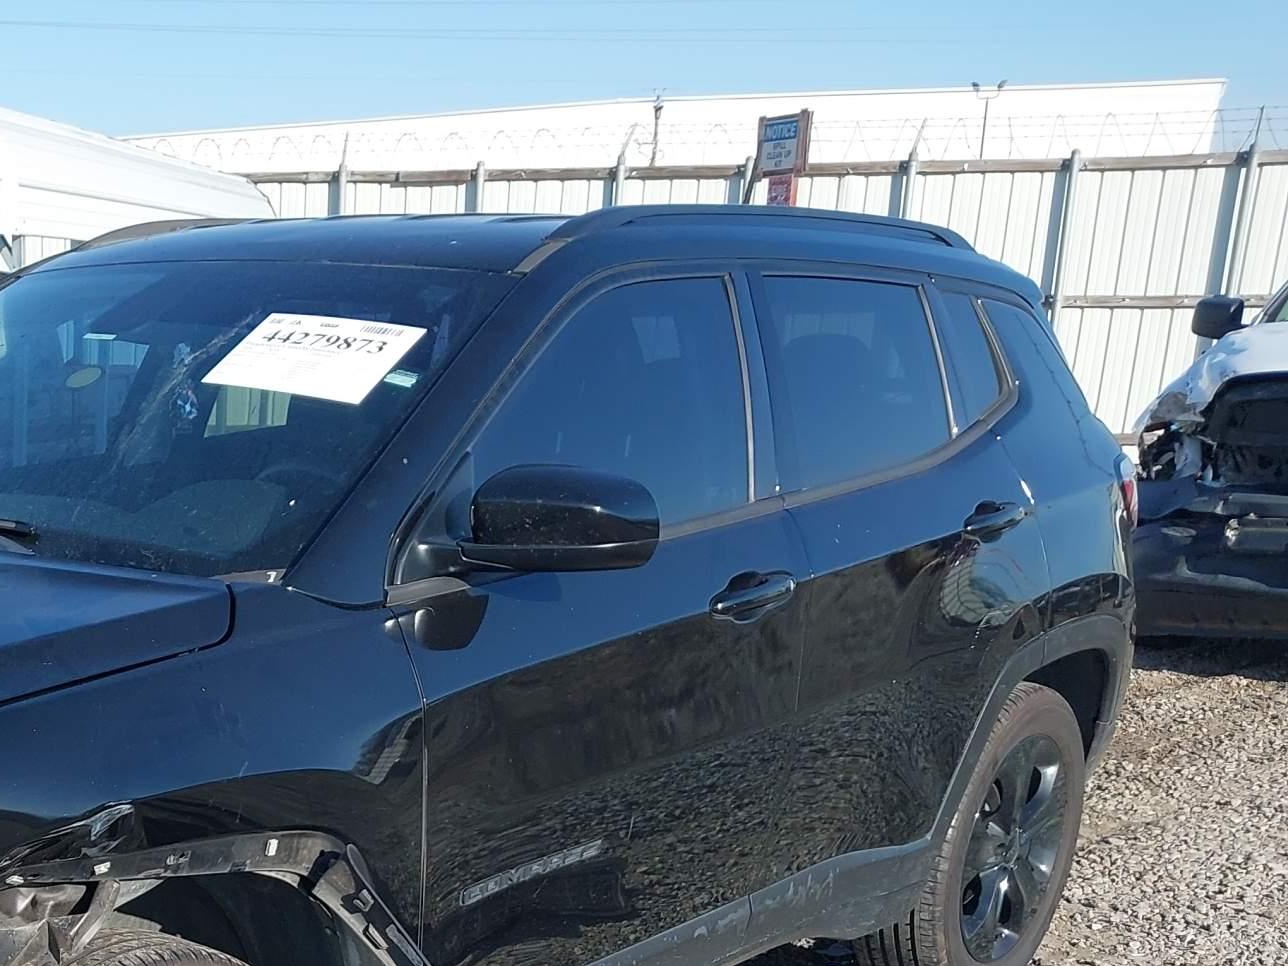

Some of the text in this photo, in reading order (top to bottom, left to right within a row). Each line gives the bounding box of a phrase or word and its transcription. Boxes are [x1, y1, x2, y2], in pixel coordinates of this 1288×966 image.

[765, 122, 798, 140] NOTICE
[766, 149, 792, 160] CLEAN UP
[261, 328, 389, 355] 44279873
